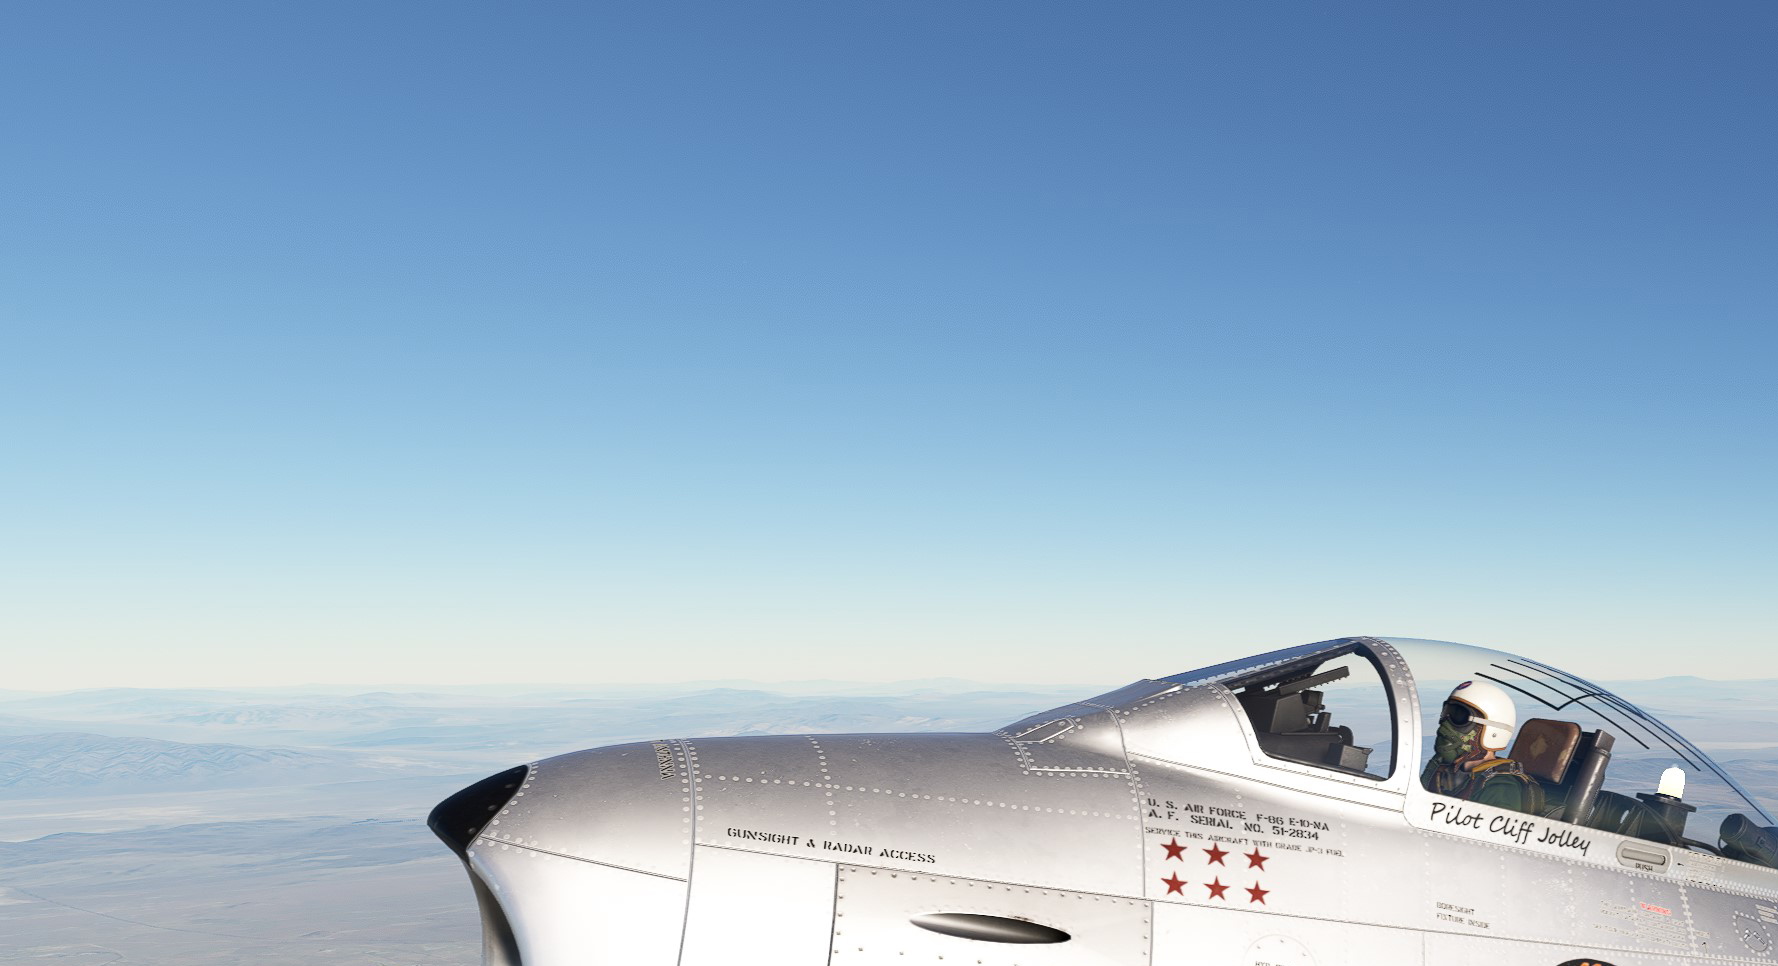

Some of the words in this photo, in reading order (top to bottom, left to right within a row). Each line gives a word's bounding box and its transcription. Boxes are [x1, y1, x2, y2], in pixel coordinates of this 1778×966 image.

[655, 741, 676, 780] NTENNA
[1148, 798, 1160, 808] U.
[1166, 800, 1178, 810] S.
[1184, 803, 1204, 814] AIR
[1209, 806, 1246, 820] FORCE
[1256, 813, 1284, 825] F-86
[1148, 809, 1162, 819] A.
[1167, 811, 1179, 821] F.
[1190, 814, 1234, 830] SERIAL
[1244, 822, 1264, 834] NO.
[1272, 826, 1319, 841] 51-2834
[1145, 826, 1181, 838] SERVICE
[1185, 831, 1203, 840] THIS
[1207, 834, 1248, 846] AIRCRAFT
[1253, 839, 1272, 848] WITH
[1276, 842, 1302, 852] GRADE
[1326, 849, 1344, 857] FUEL
[1430, 802, 1484, 829] Pilot
[1489, 815, 1535, 845] Cliff
[1537, 827, 1591, 857] Jolley
[727, 827, 799, 845] GUNSIGHT
[806, 839, 815, 848] &
[823, 840, 873, 855] RADAR
[880, 848, 936, 864] ACCESS
[1635, 862, 1654, 871] PUSH
[1436, 912, 1465, 924] FIXTURE
